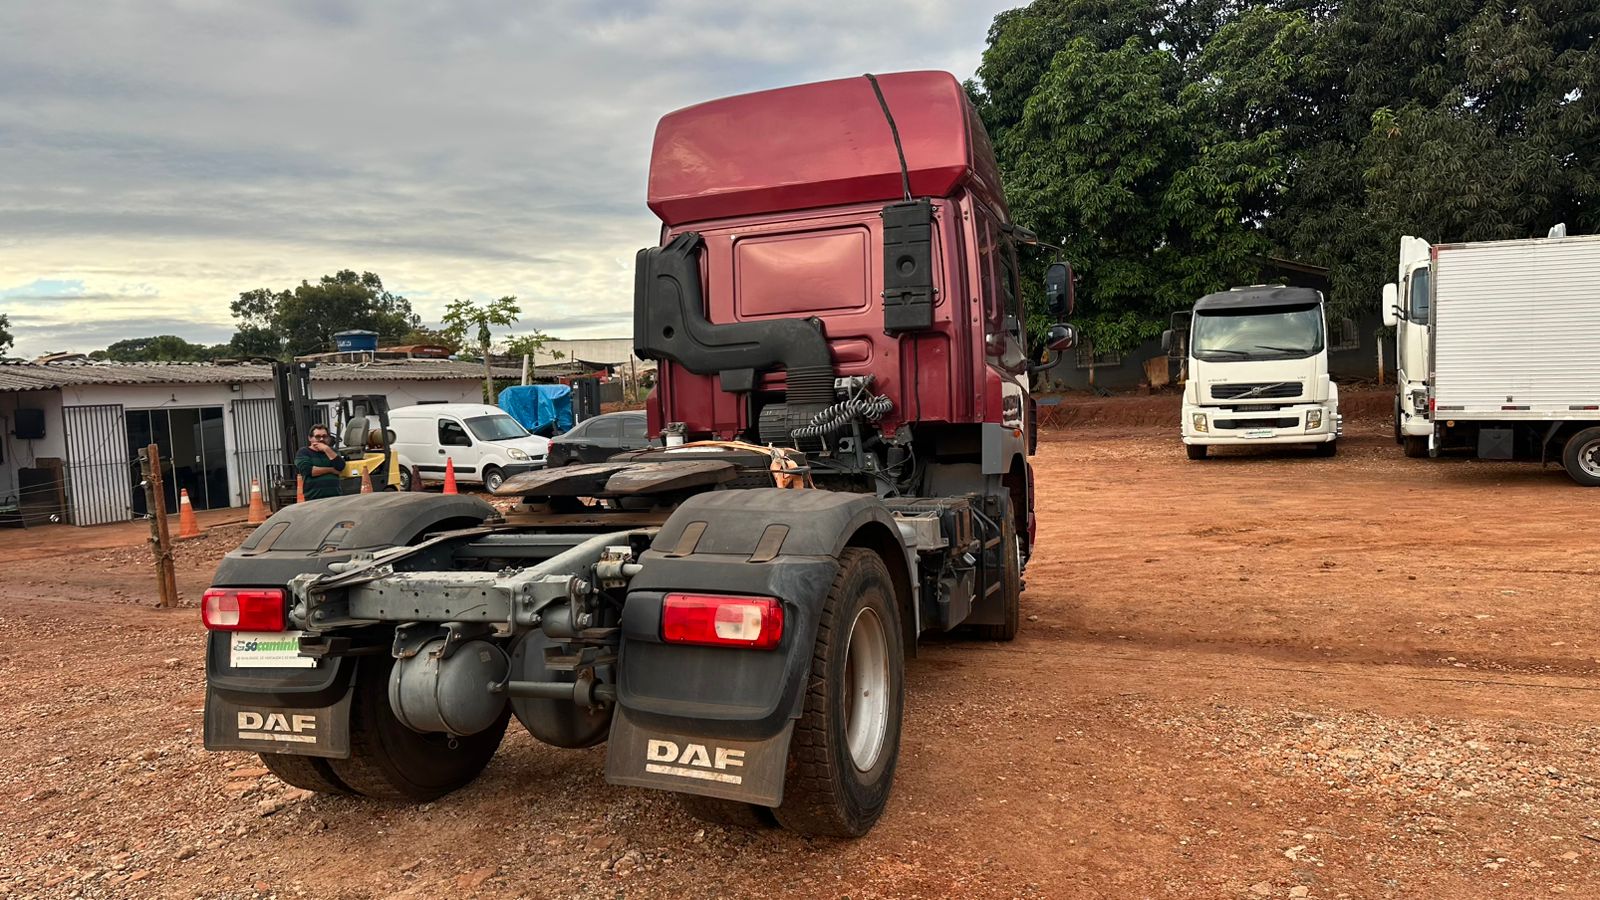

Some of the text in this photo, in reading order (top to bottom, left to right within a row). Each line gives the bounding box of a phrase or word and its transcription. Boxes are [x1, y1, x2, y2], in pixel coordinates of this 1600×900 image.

[244, 637, 298, 652] sócaminh
[237, 711, 316, 733] DAF
[646, 739, 746, 770] DAF
